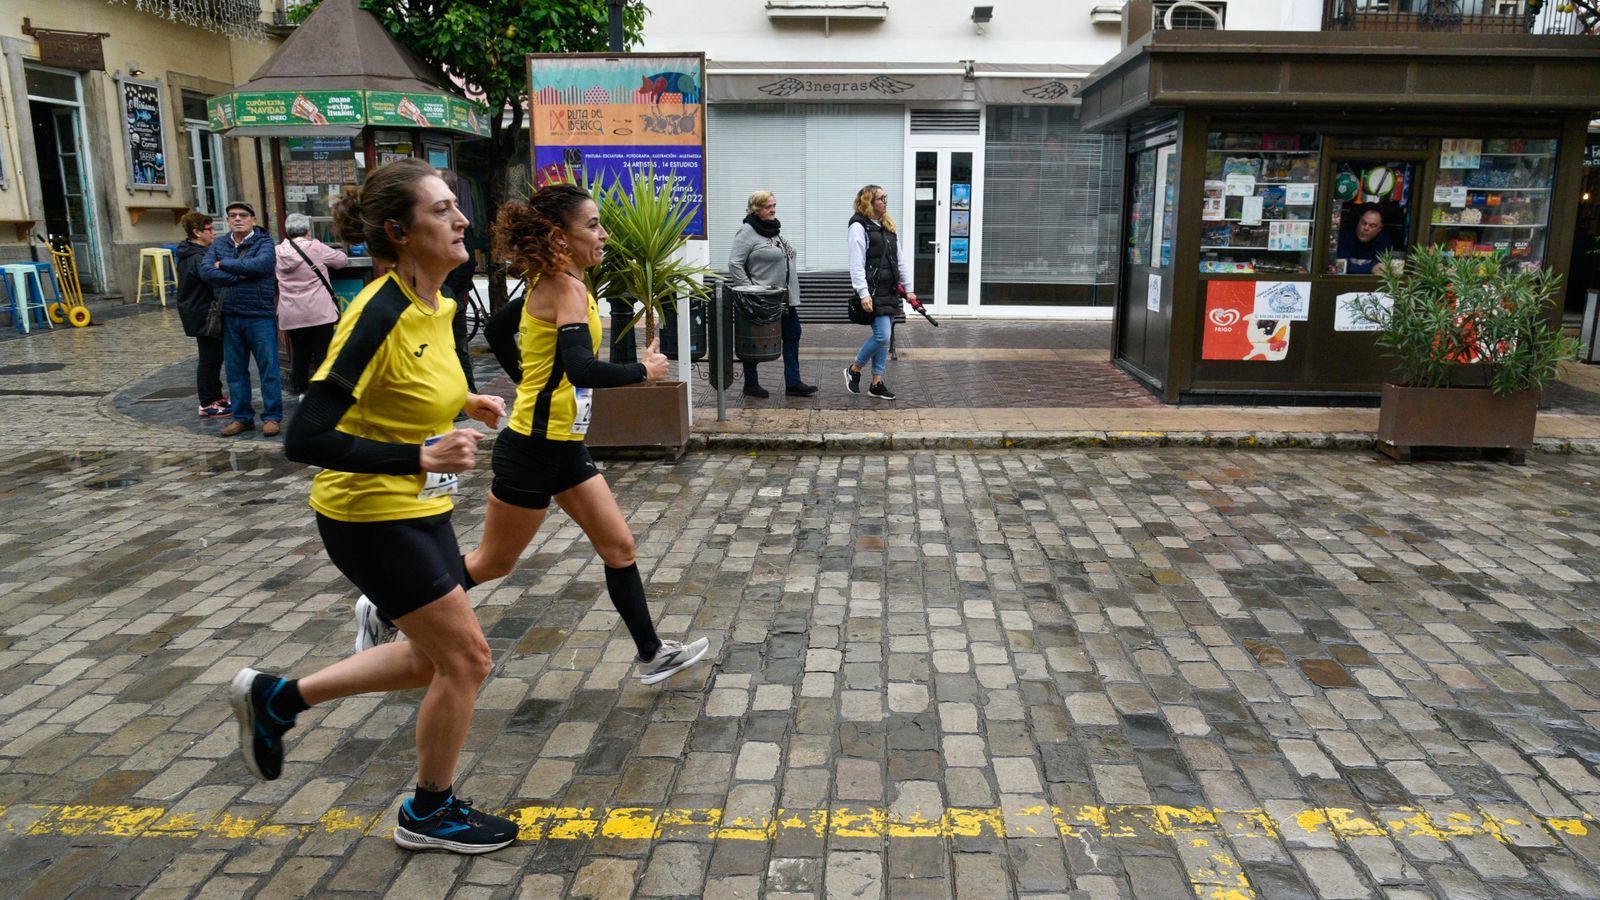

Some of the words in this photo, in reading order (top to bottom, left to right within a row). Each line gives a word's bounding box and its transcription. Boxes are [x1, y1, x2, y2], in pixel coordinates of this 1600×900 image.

[805, 80, 869, 94] 3negras
[251, 106, 286, 114] NAVIDAD
[567, 109, 588, 120] RUTA
[591, 109, 604, 119] DEL
[682, 194, 703, 203] 2022
